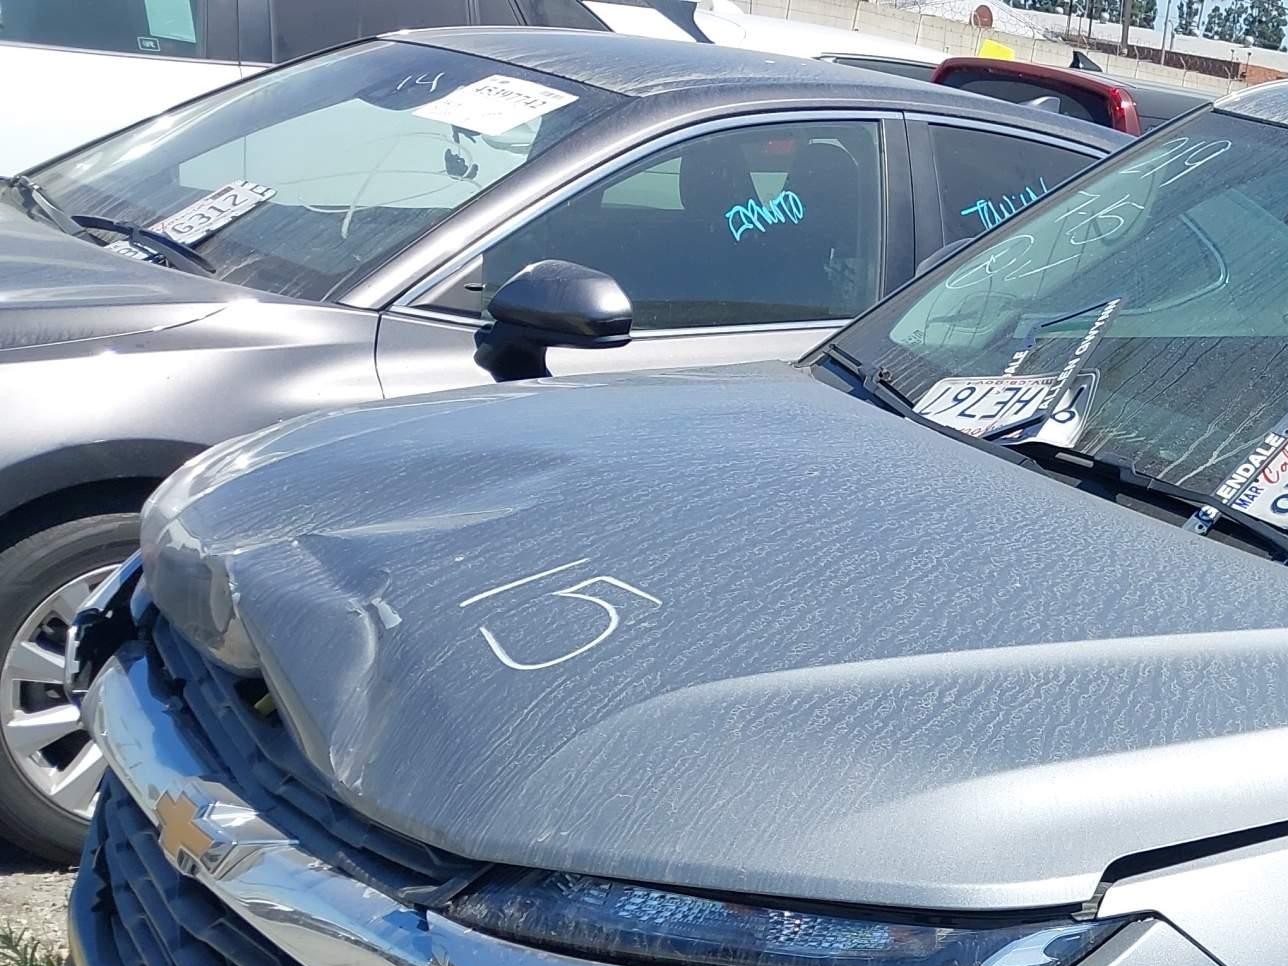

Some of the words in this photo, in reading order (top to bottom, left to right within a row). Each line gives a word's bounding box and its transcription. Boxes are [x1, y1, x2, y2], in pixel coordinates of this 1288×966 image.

[396, 71, 445, 93] 14
[1118, 136, 1232, 189] 219
[1038, 356, 1081, 411] ALLEN
[1232, 484, 1265, 512] MAR
